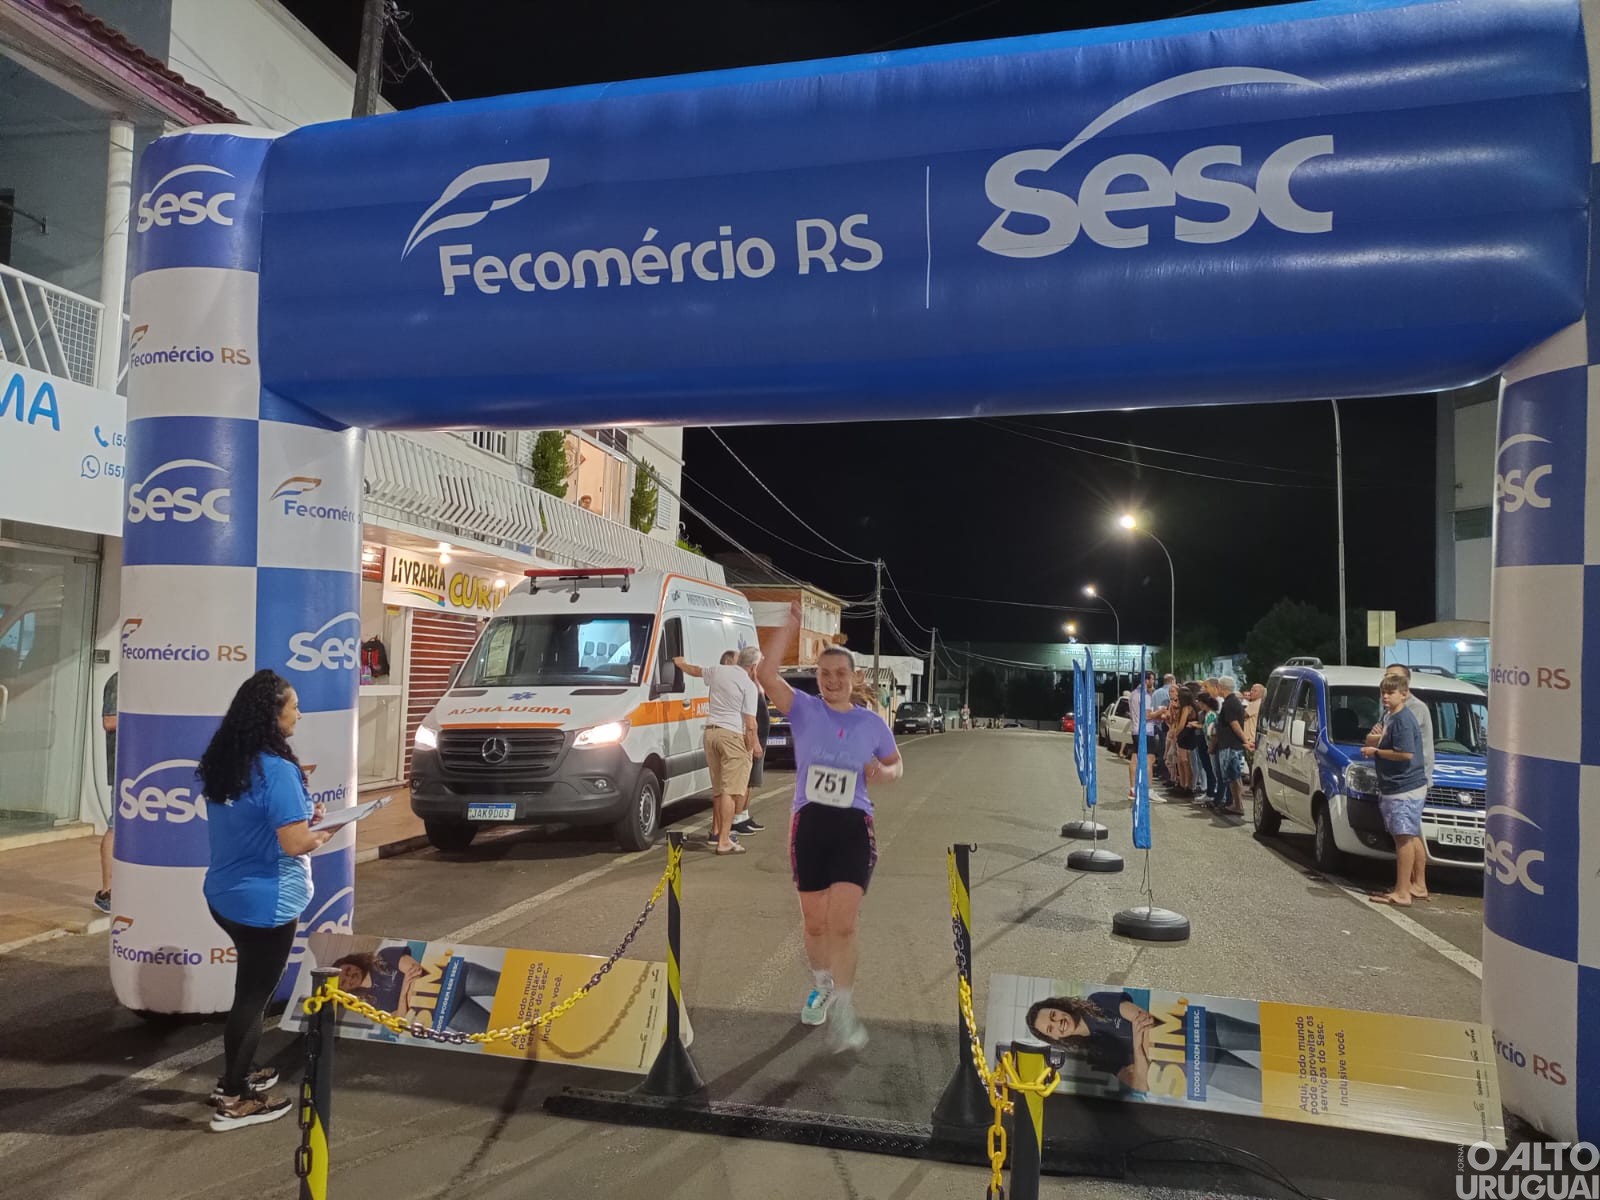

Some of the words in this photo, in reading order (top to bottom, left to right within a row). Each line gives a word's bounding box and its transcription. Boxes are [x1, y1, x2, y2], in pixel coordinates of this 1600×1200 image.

[439, 226, 776, 296] Fecomércio
[796, 213, 884, 276] RS
[131, 345, 215, 369] Fecomércio
[220, 346, 251, 366] RS
[104, 461, 125, 479] (55)
[122, 642, 210, 662] Fecomércio
[217, 644, 248, 662] RS
[1537, 667, 1571, 690] RS
[814, 769, 848, 795] 751
[112, 938, 203, 966] Fecomércio
[210, 946, 239, 965] RS
[523, 962, 536, 995] mundo
[535, 993, 543, 1006] do
[1295, 1015, 1305, 1051] mundo
[1306, 1015, 1314, 1027] os
[1307, 1029, 1319, 1083] aproveitar
[1335, 1029, 1345, 1056] você.
[1297, 1054, 1307, 1079] todo
[1317, 1050, 1326, 1064] do
[1532, 1053, 1567, 1086] RS
[1318, 1067, 1328, 1112] serviços
[1338, 1059, 1349, 1107] Inclusive
[1298, 1083, 1309, 1112] Aqui,
[1309, 1087, 1319, 1115] pode
